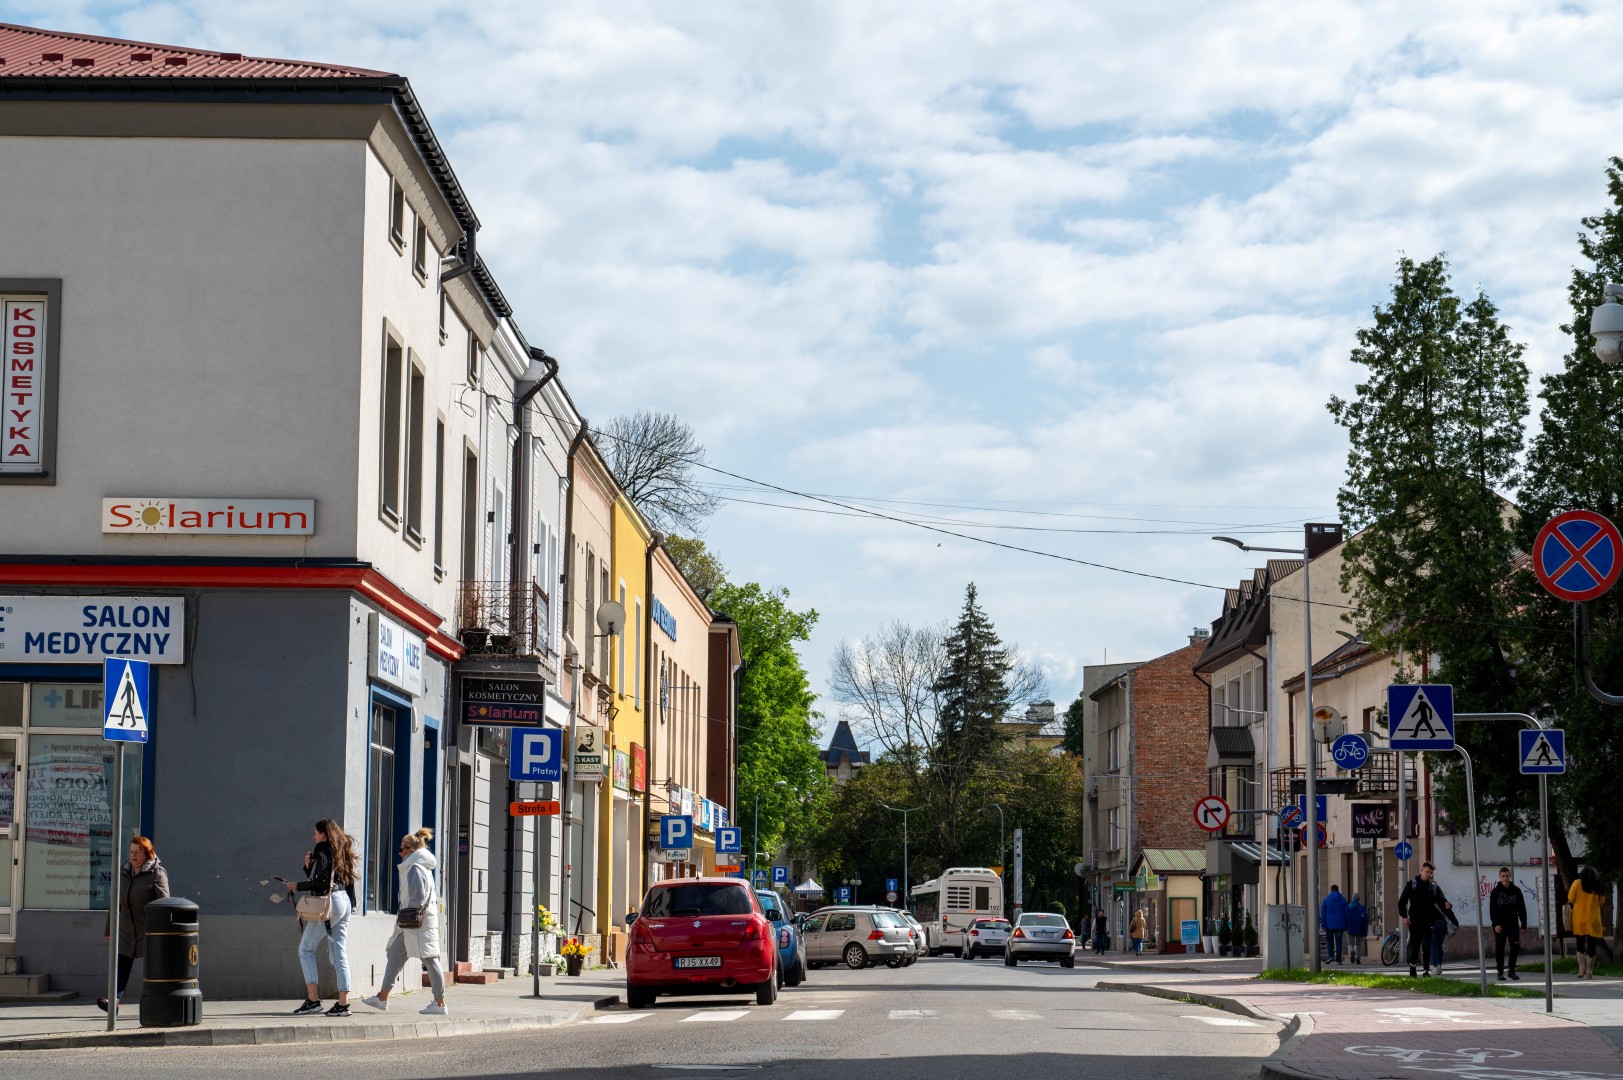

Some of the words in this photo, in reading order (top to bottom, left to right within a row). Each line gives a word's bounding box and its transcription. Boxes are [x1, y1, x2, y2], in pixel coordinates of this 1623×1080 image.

[8, 308, 36, 457] KOSMETYKA
[109, 503, 307, 529] Solarium
[83, 605, 171, 628] SALON
[24, 632, 171, 655] MEDYCZNY
[468, 691, 539, 702] KOSMETYCZNY
[488, 683, 520, 691] SALON
[65, 689, 103, 709] LIF
[522, 733, 551, 774] P
[518, 804, 546, 814] Strefa
[667, 819, 687, 845] P
[721, 830, 736, 850] P
[680, 958, 697, 967] RJS
[699, 957, 719, 966] XX49
